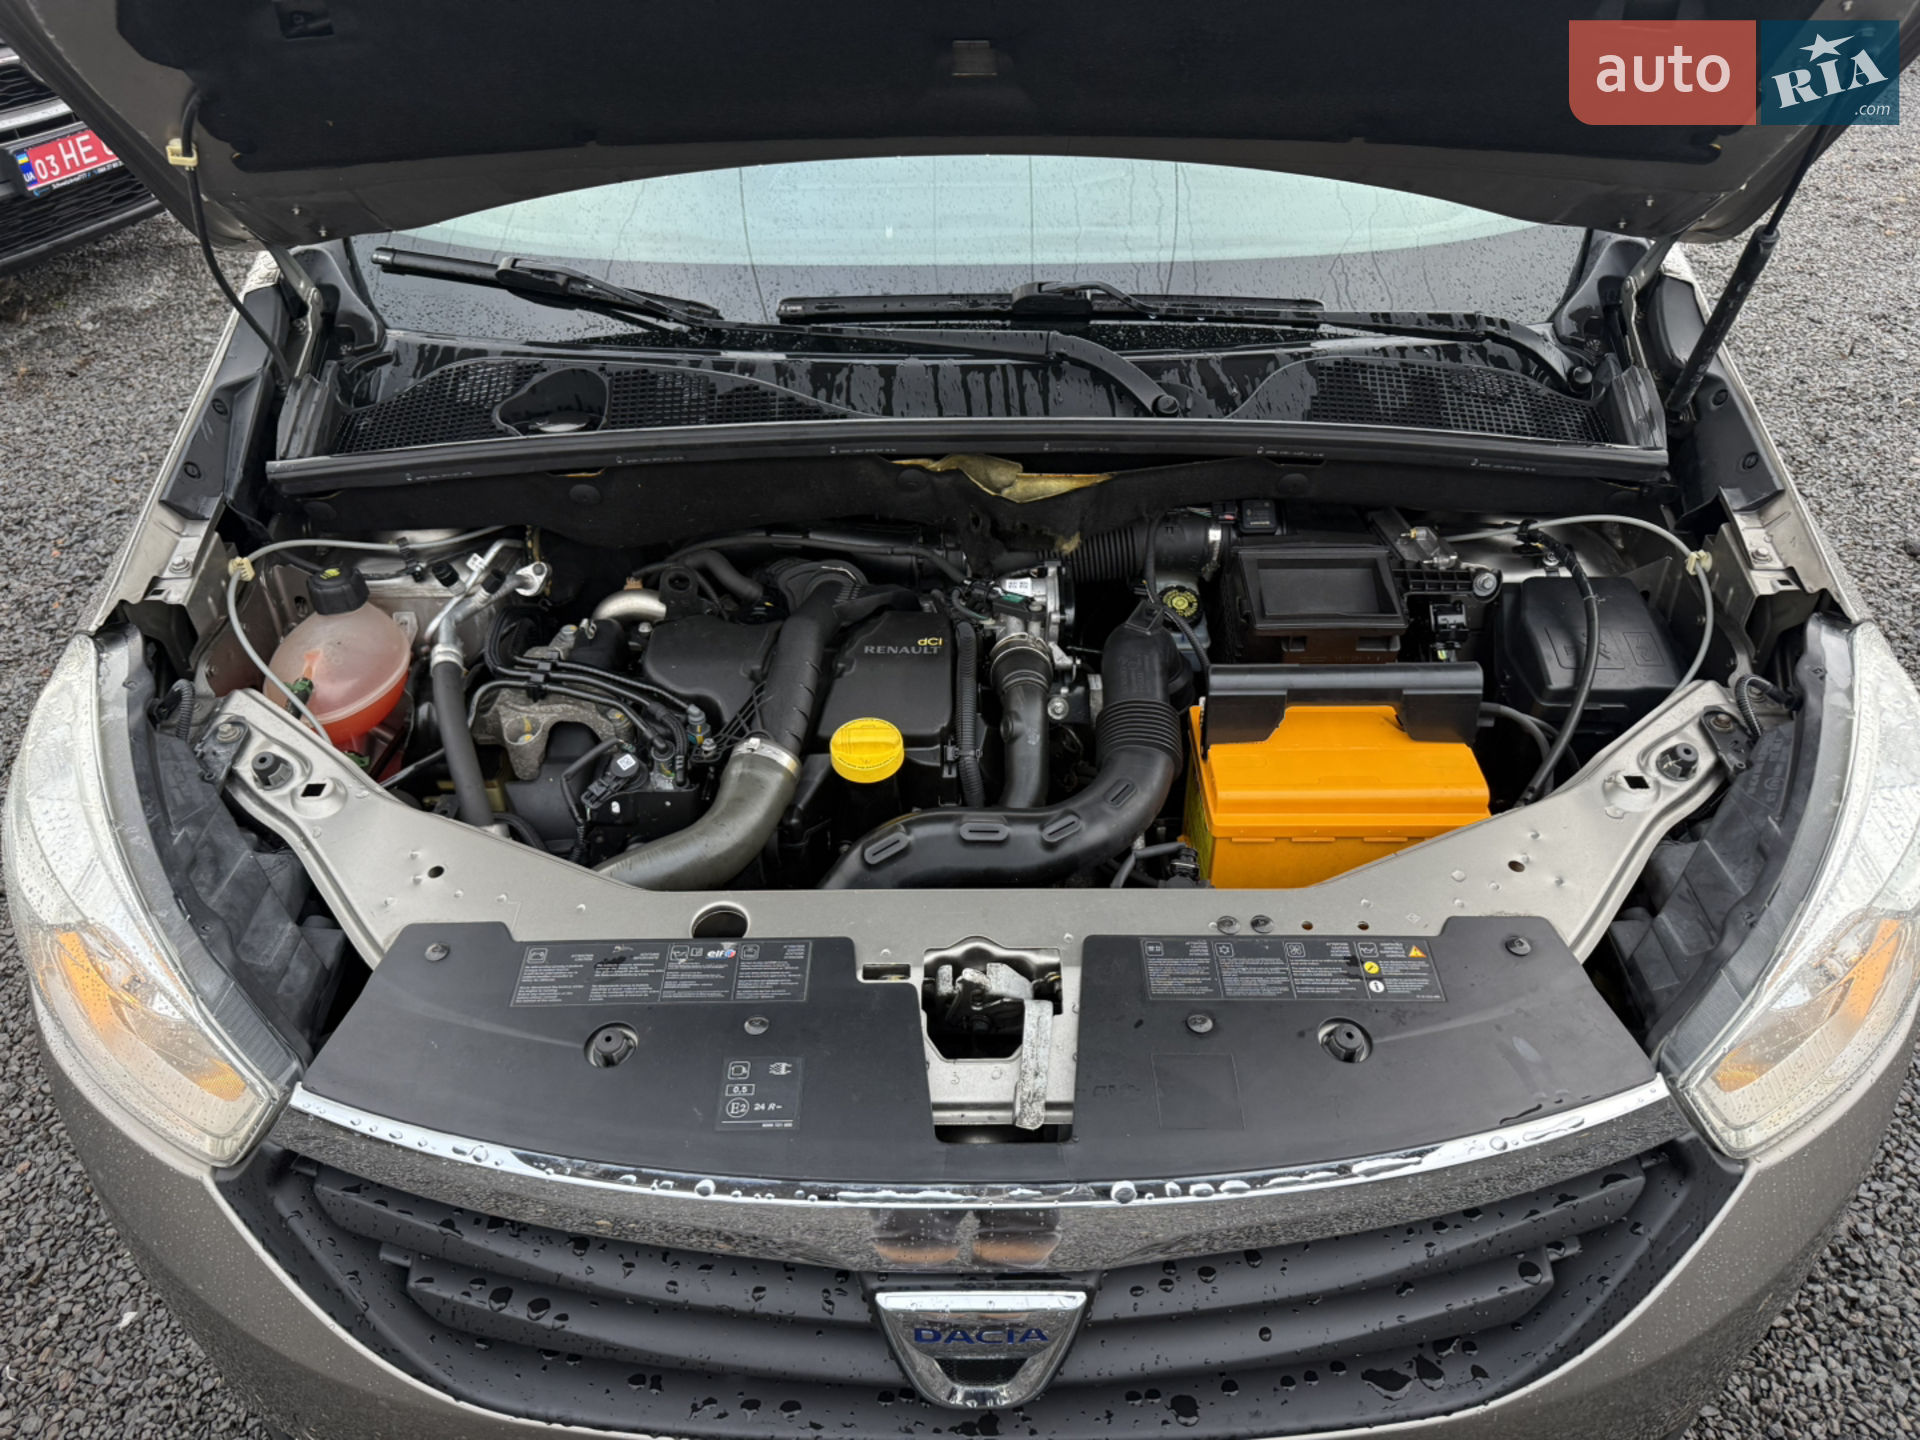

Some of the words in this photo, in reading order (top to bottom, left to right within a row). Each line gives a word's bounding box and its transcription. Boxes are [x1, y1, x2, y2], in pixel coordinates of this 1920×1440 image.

[35, 154, 60, 180] 03
[58, 134, 98, 170] HE
[23, 171, 36, 183] UA
[864, 645, 941, 655] RENAULT
[707, 950, 726, 958] elf
[753, 1103, 766, 1111] 24
[914, 1328, 1049, 1344] DACIA
